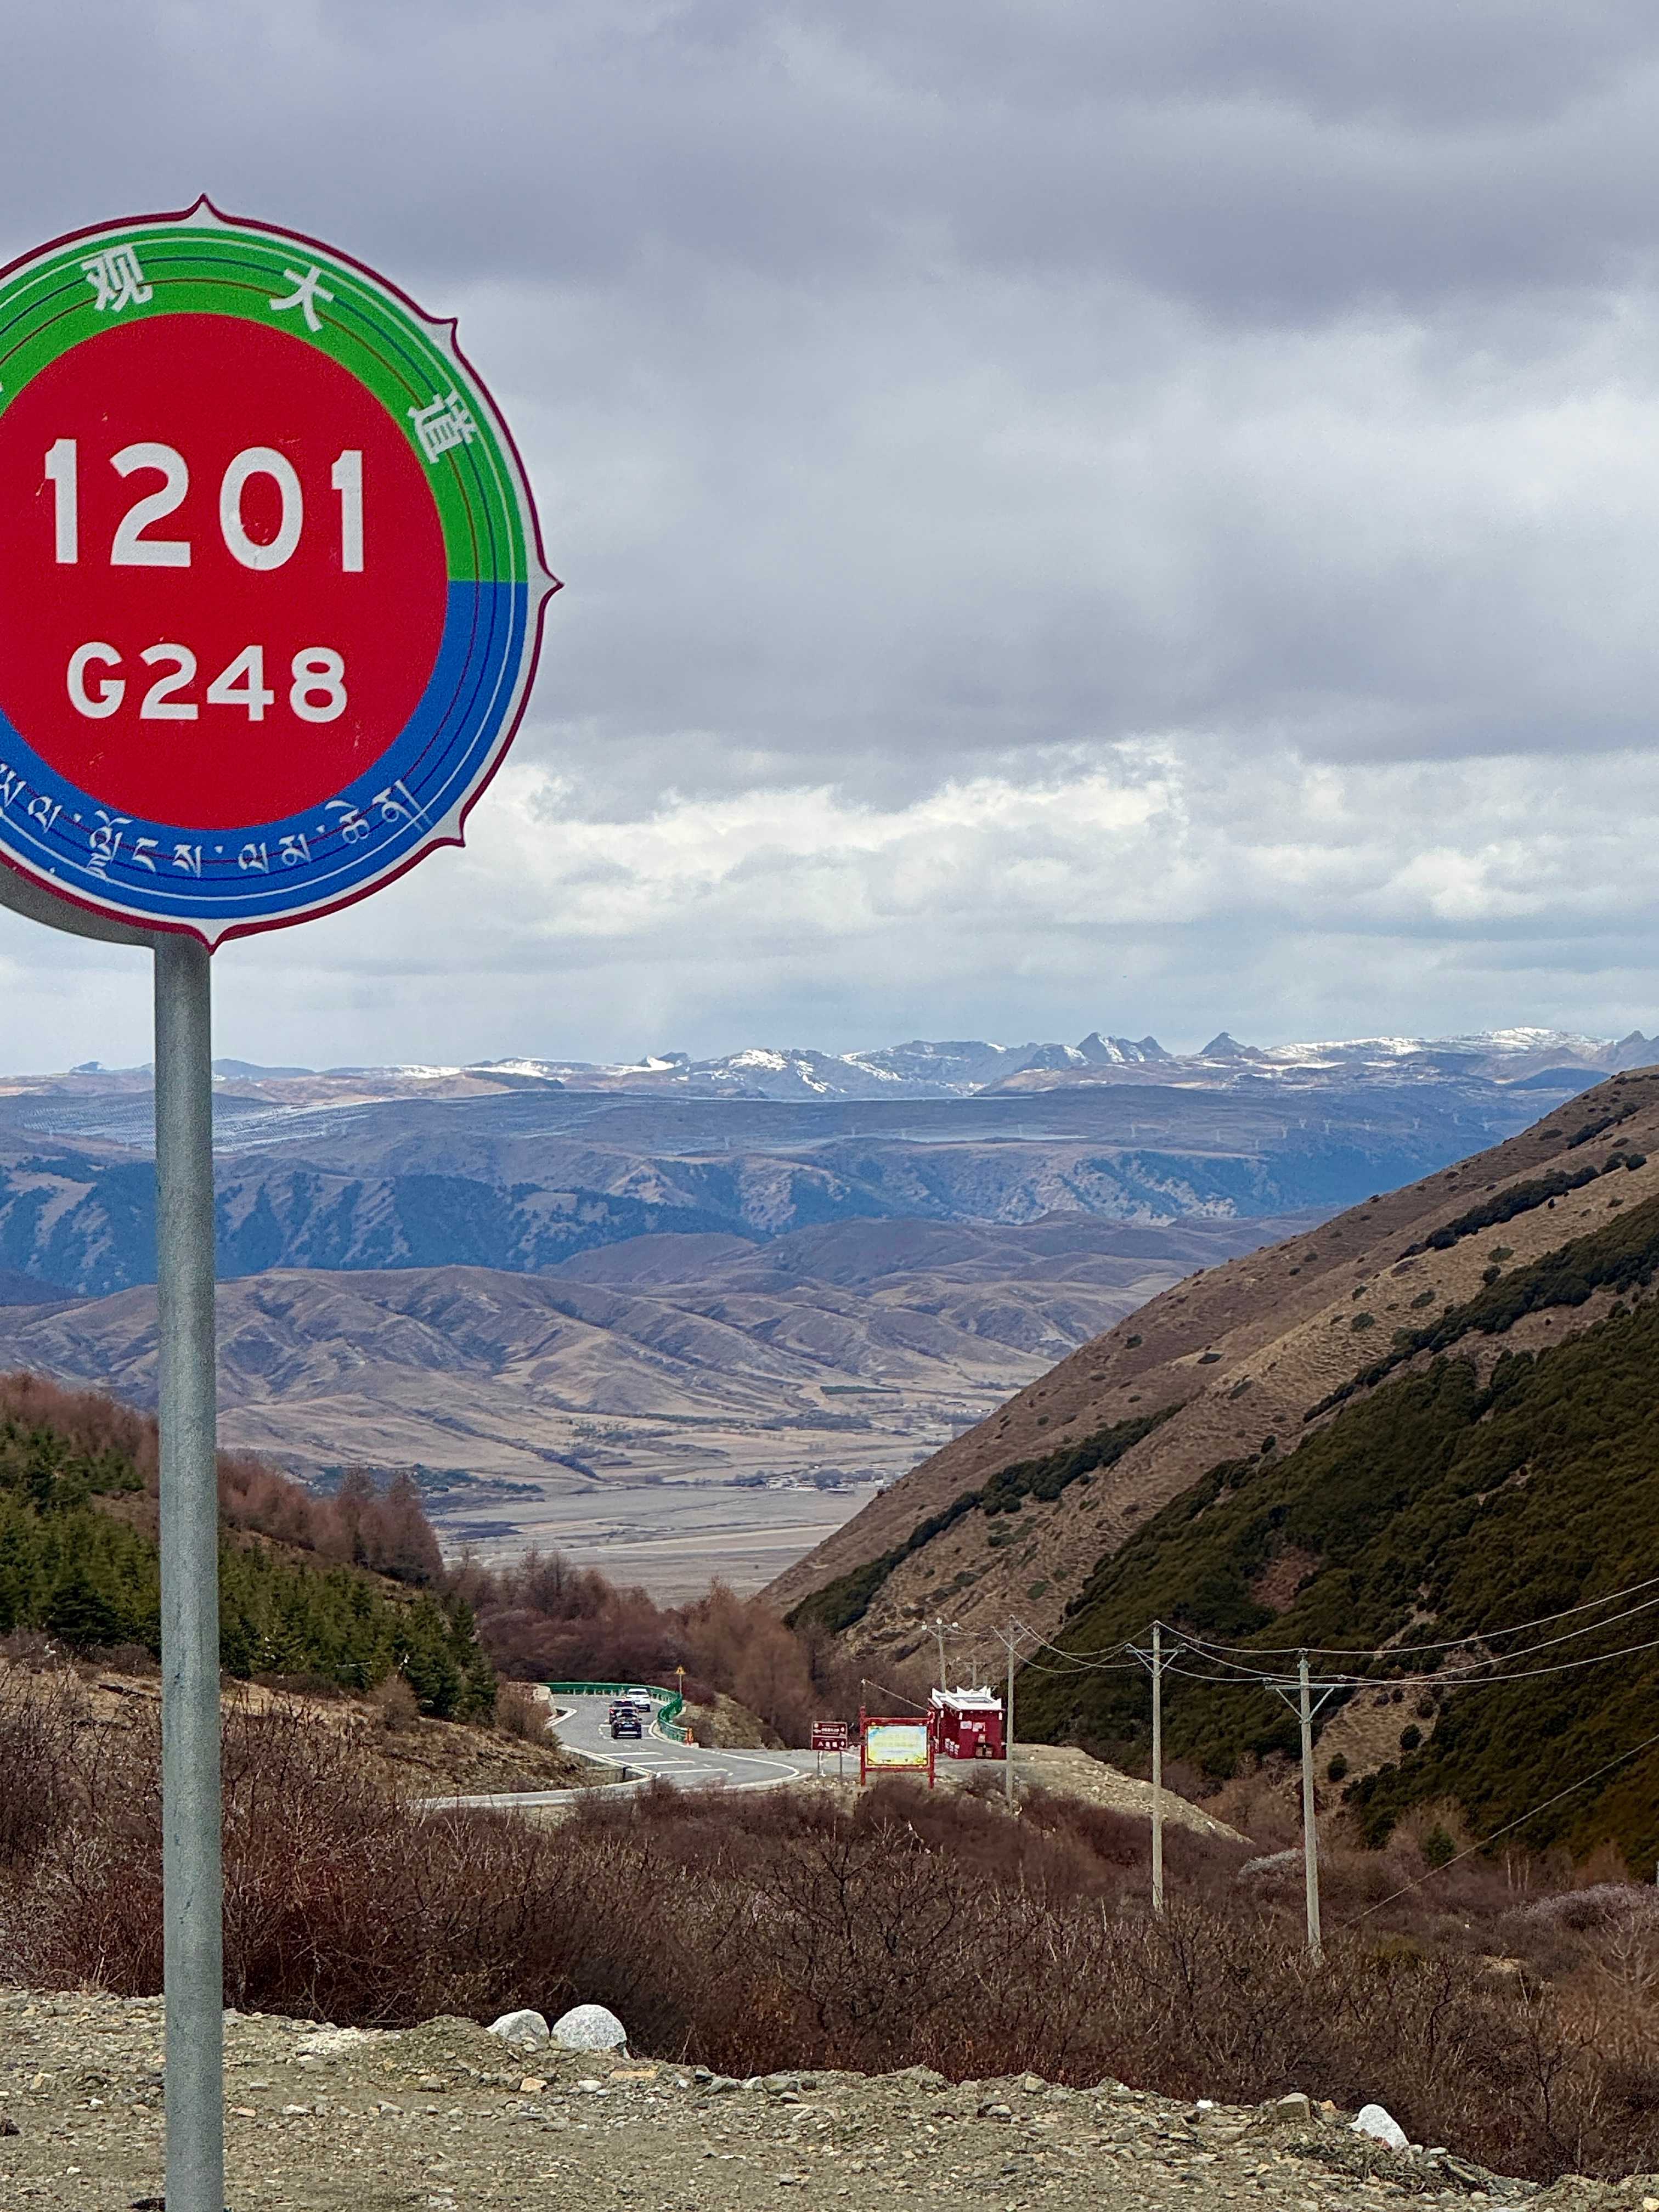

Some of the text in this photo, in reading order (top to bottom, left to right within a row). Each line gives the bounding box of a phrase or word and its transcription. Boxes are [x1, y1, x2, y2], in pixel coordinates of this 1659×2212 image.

[0, 245, 478, 464] 观大道
[44, 438, 364, 573] 1201
[66, 641, 348, 723] G248
